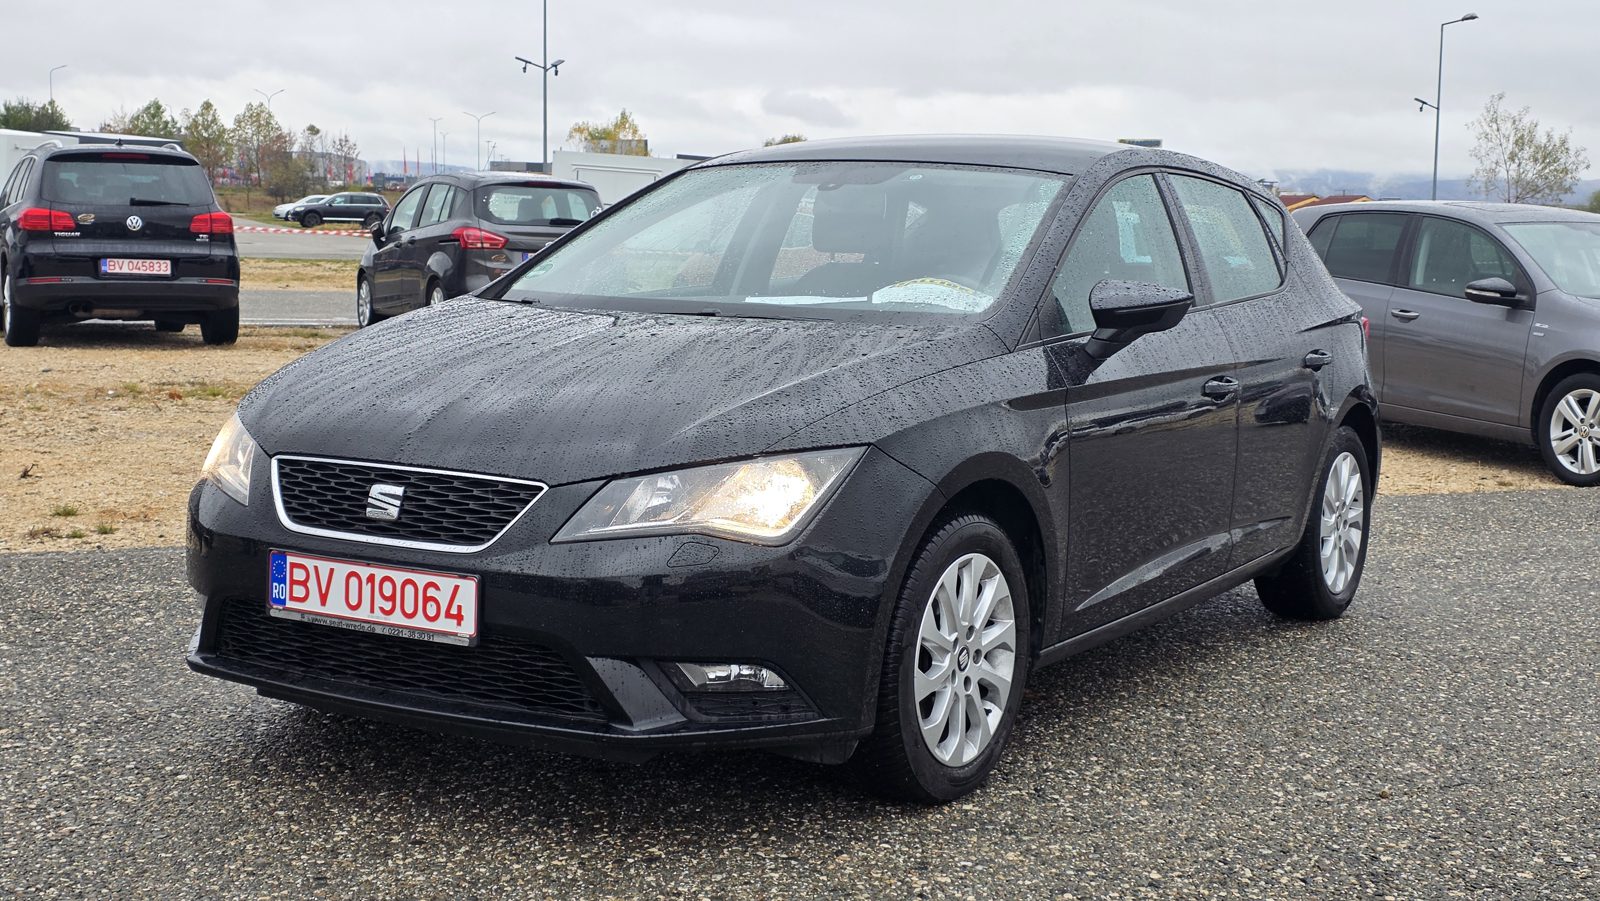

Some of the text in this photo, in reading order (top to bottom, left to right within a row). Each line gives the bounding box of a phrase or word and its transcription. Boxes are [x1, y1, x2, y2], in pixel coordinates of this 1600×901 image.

[108, 260, 125, 271] BV
[127, 261, 169, 272] 045833
[272, 582, 286, 600] RO
[289, 561, 465, 627] BV 019064
